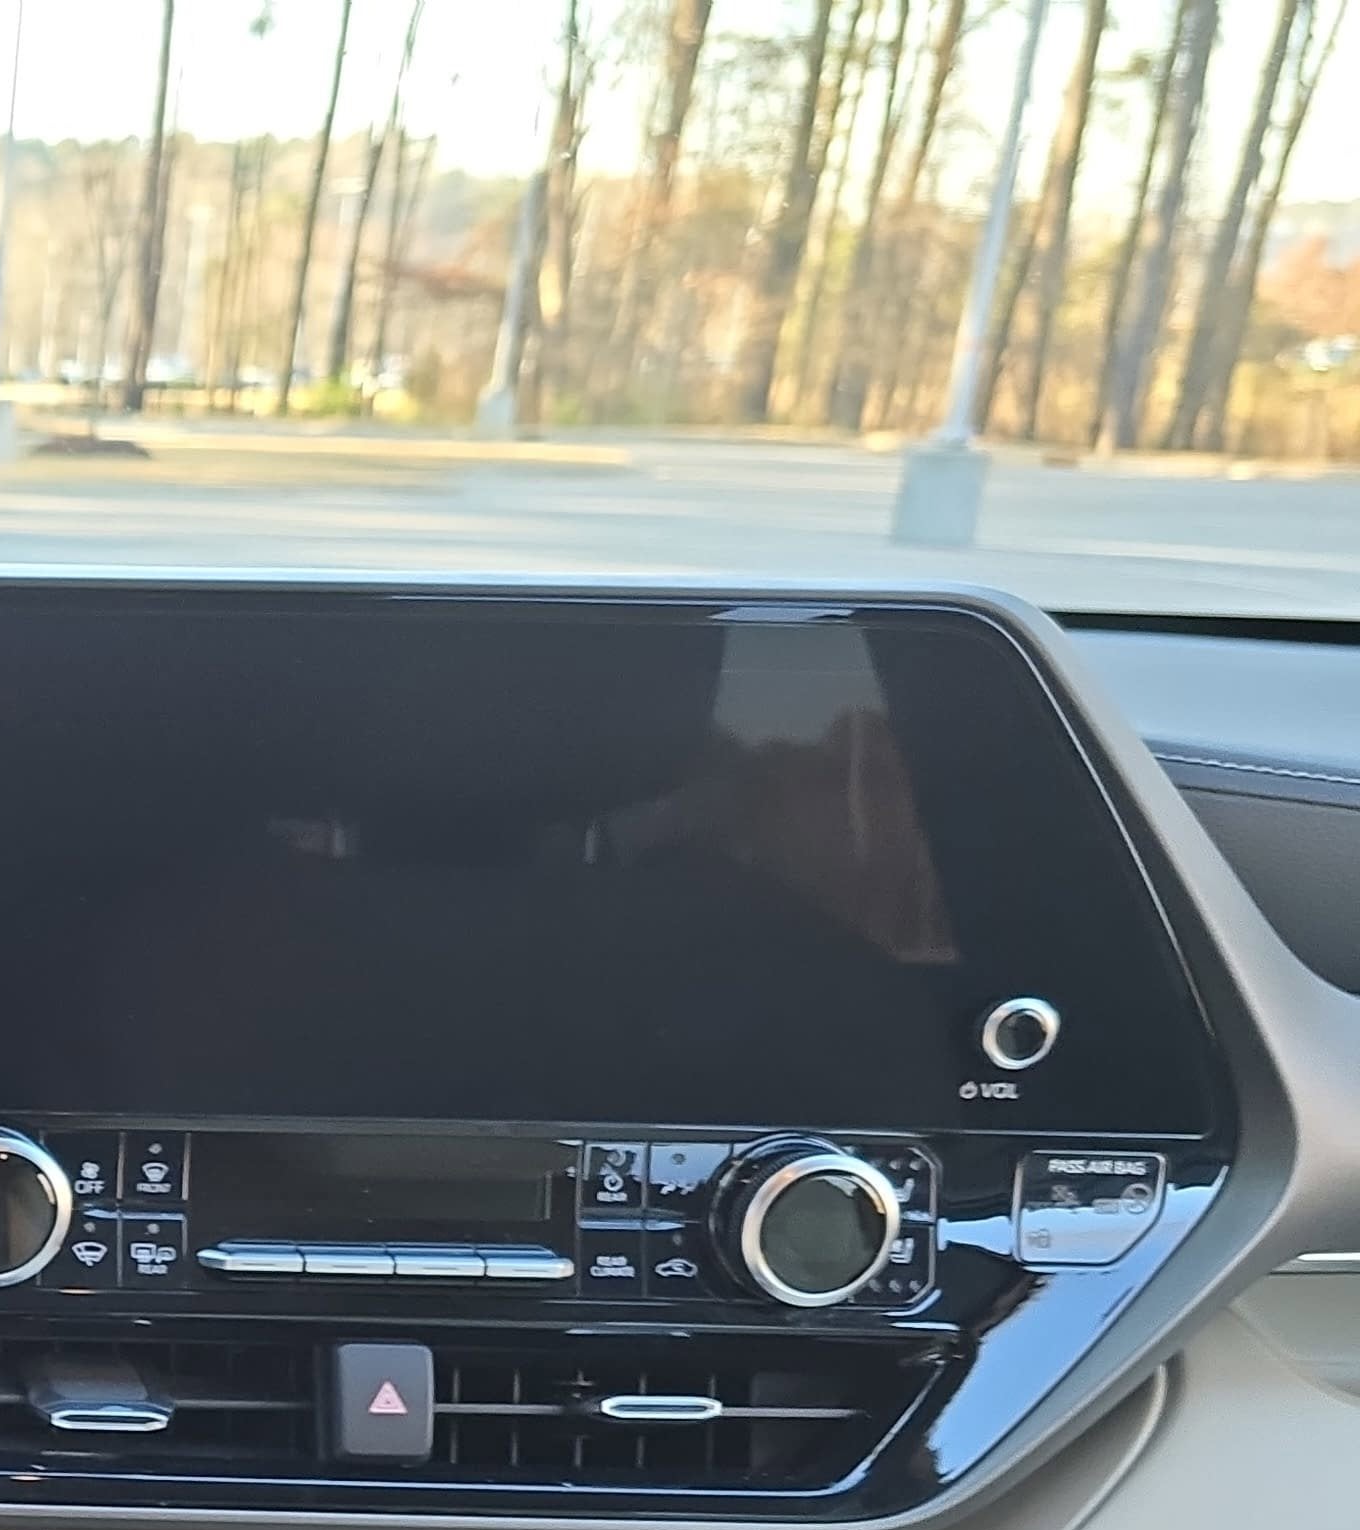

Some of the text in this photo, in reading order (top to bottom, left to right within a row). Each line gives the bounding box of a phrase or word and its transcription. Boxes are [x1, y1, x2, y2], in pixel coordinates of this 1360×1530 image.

[981, 1083, 1018, 1099] VOL
[1048, 1159, 1146, 1176] PASS AIR BAG
[74, 1180, 104, 1194] OFF
